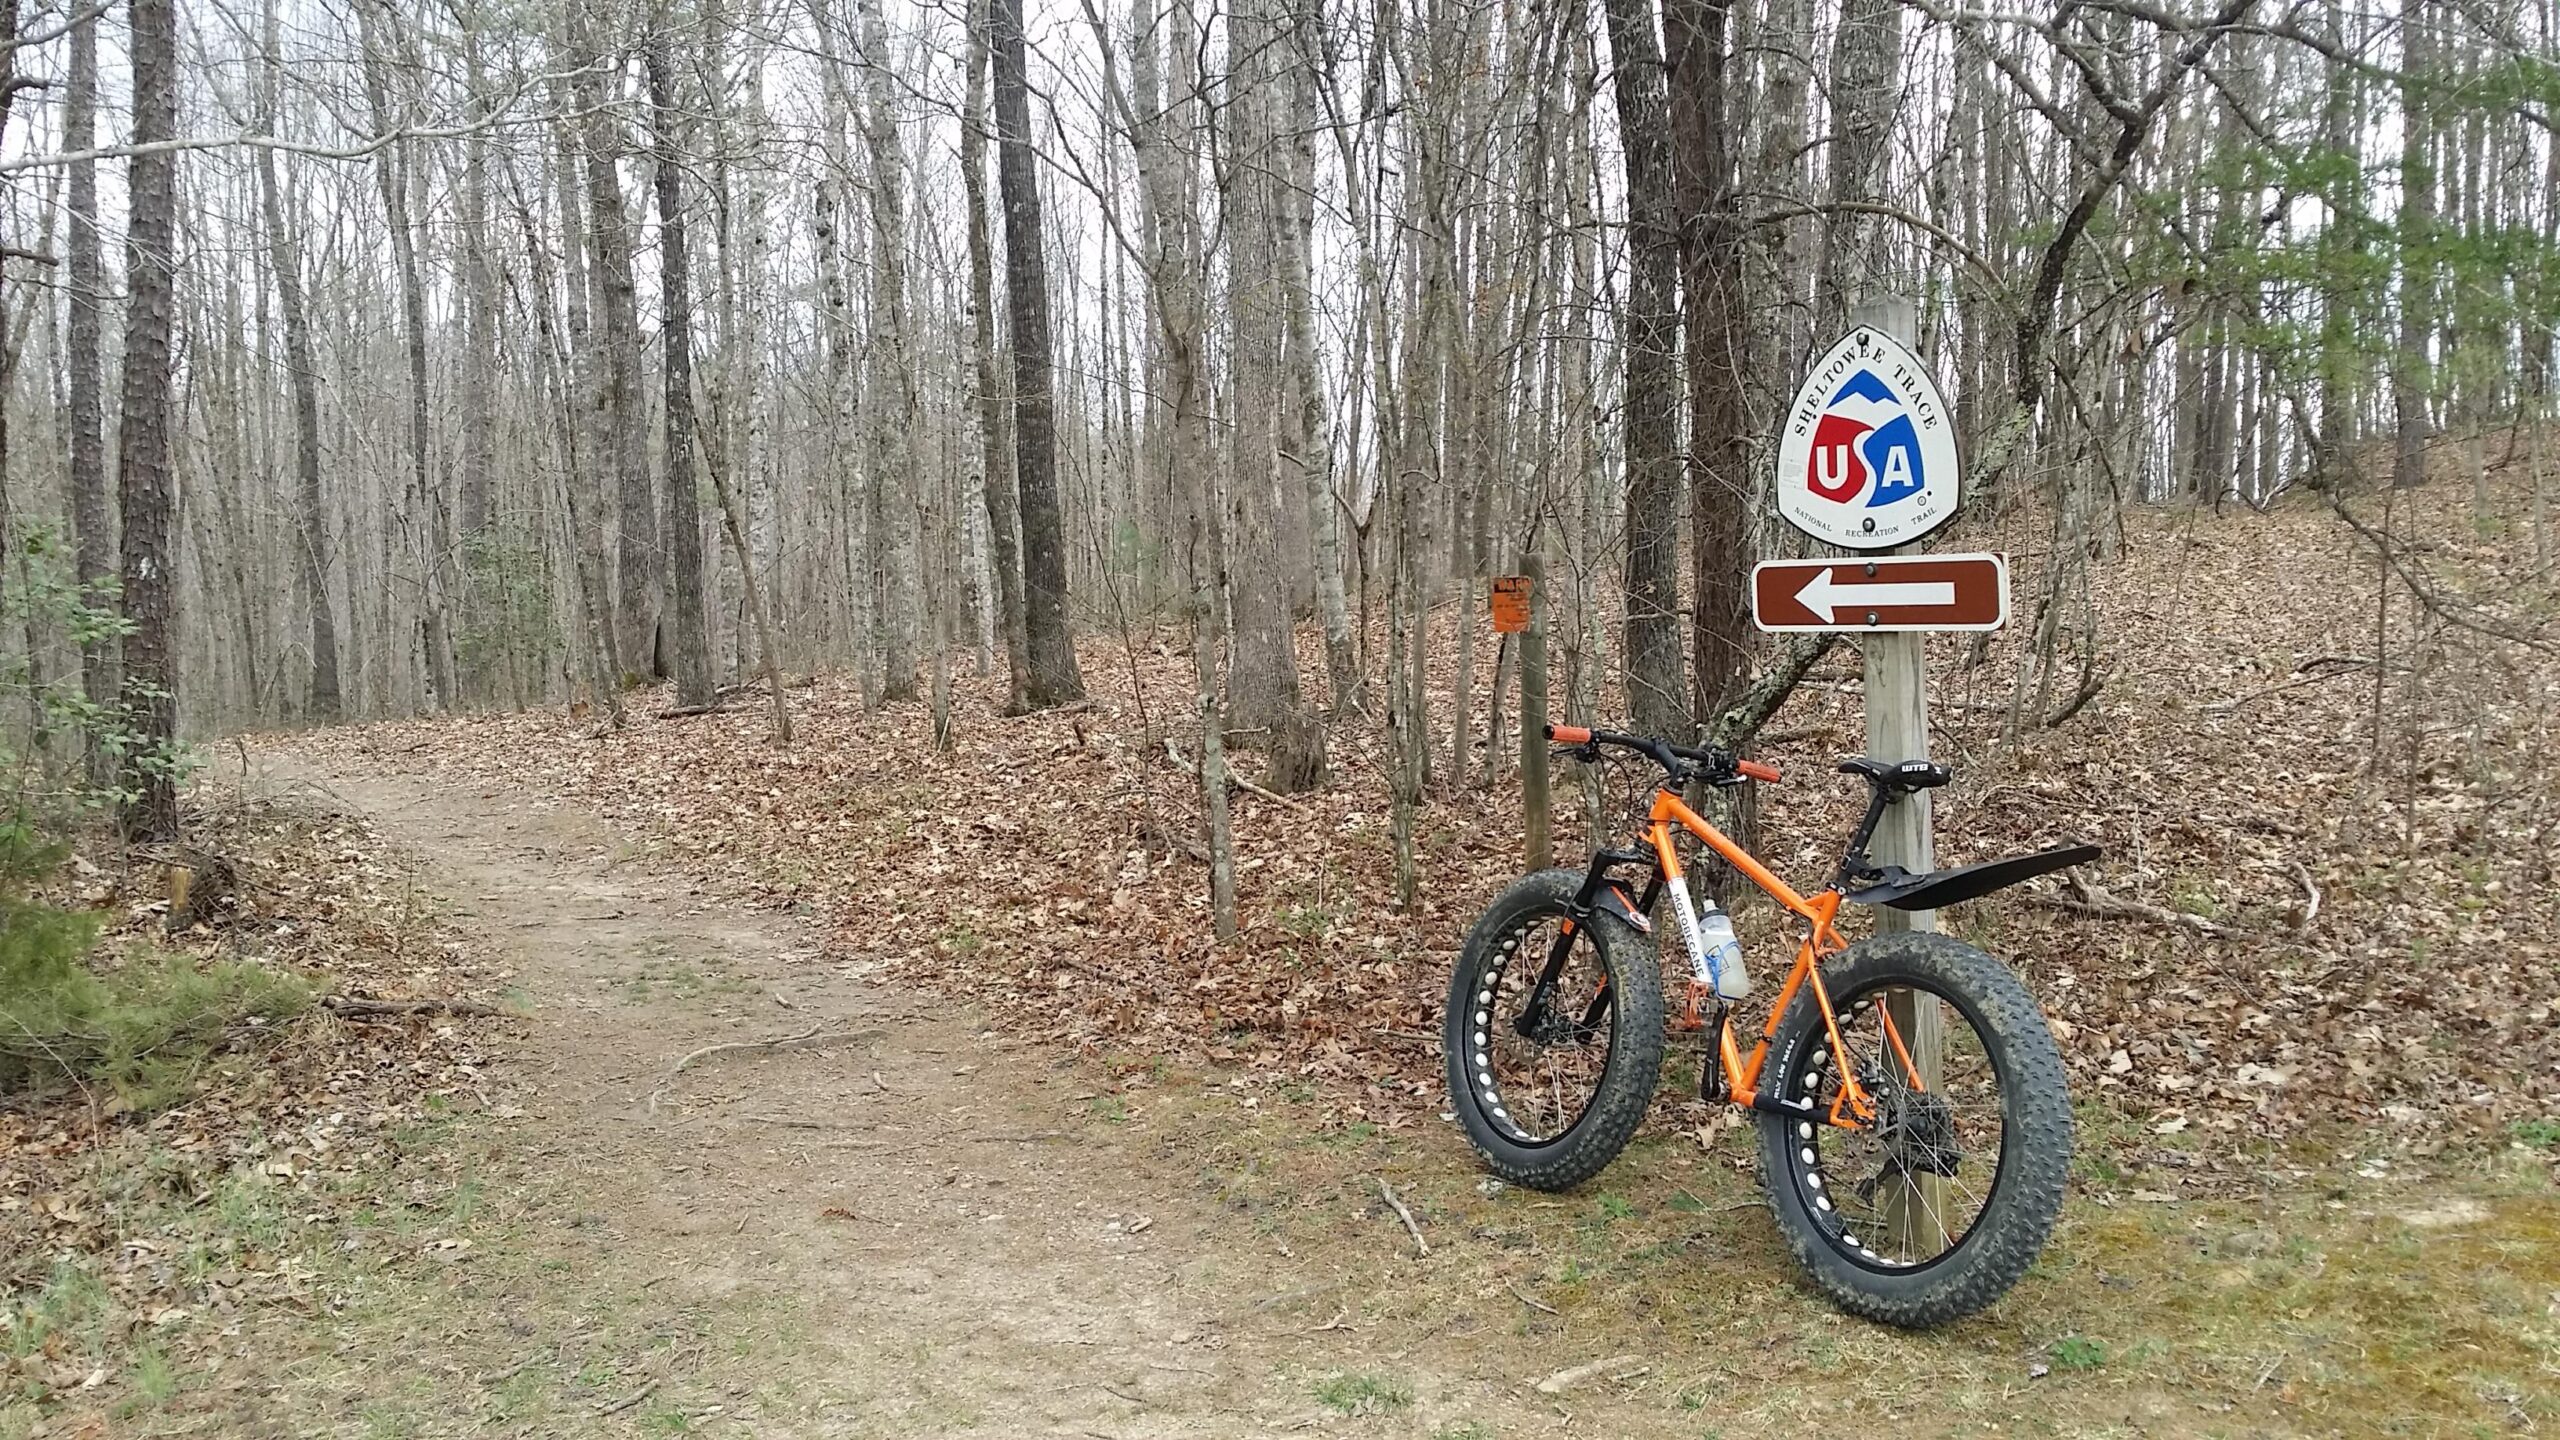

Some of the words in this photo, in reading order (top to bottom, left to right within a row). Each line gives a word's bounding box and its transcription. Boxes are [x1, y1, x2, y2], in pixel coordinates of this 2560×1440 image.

[1795, 343, 1886, 437] SHELTOWEE
[1893, 364, 1938, 430] TRACE
[1815, 434, 1915, 504] USA
[1794, 507, 1832, 532] NATIONAL
[1845, 525, 1900, 538] RECREATION
[1911, 507, 1938, 526] TRAIL
[1901, 763, 1929, 773] WTB
[1673, 893, 1705, 977] MOTOBECANE
